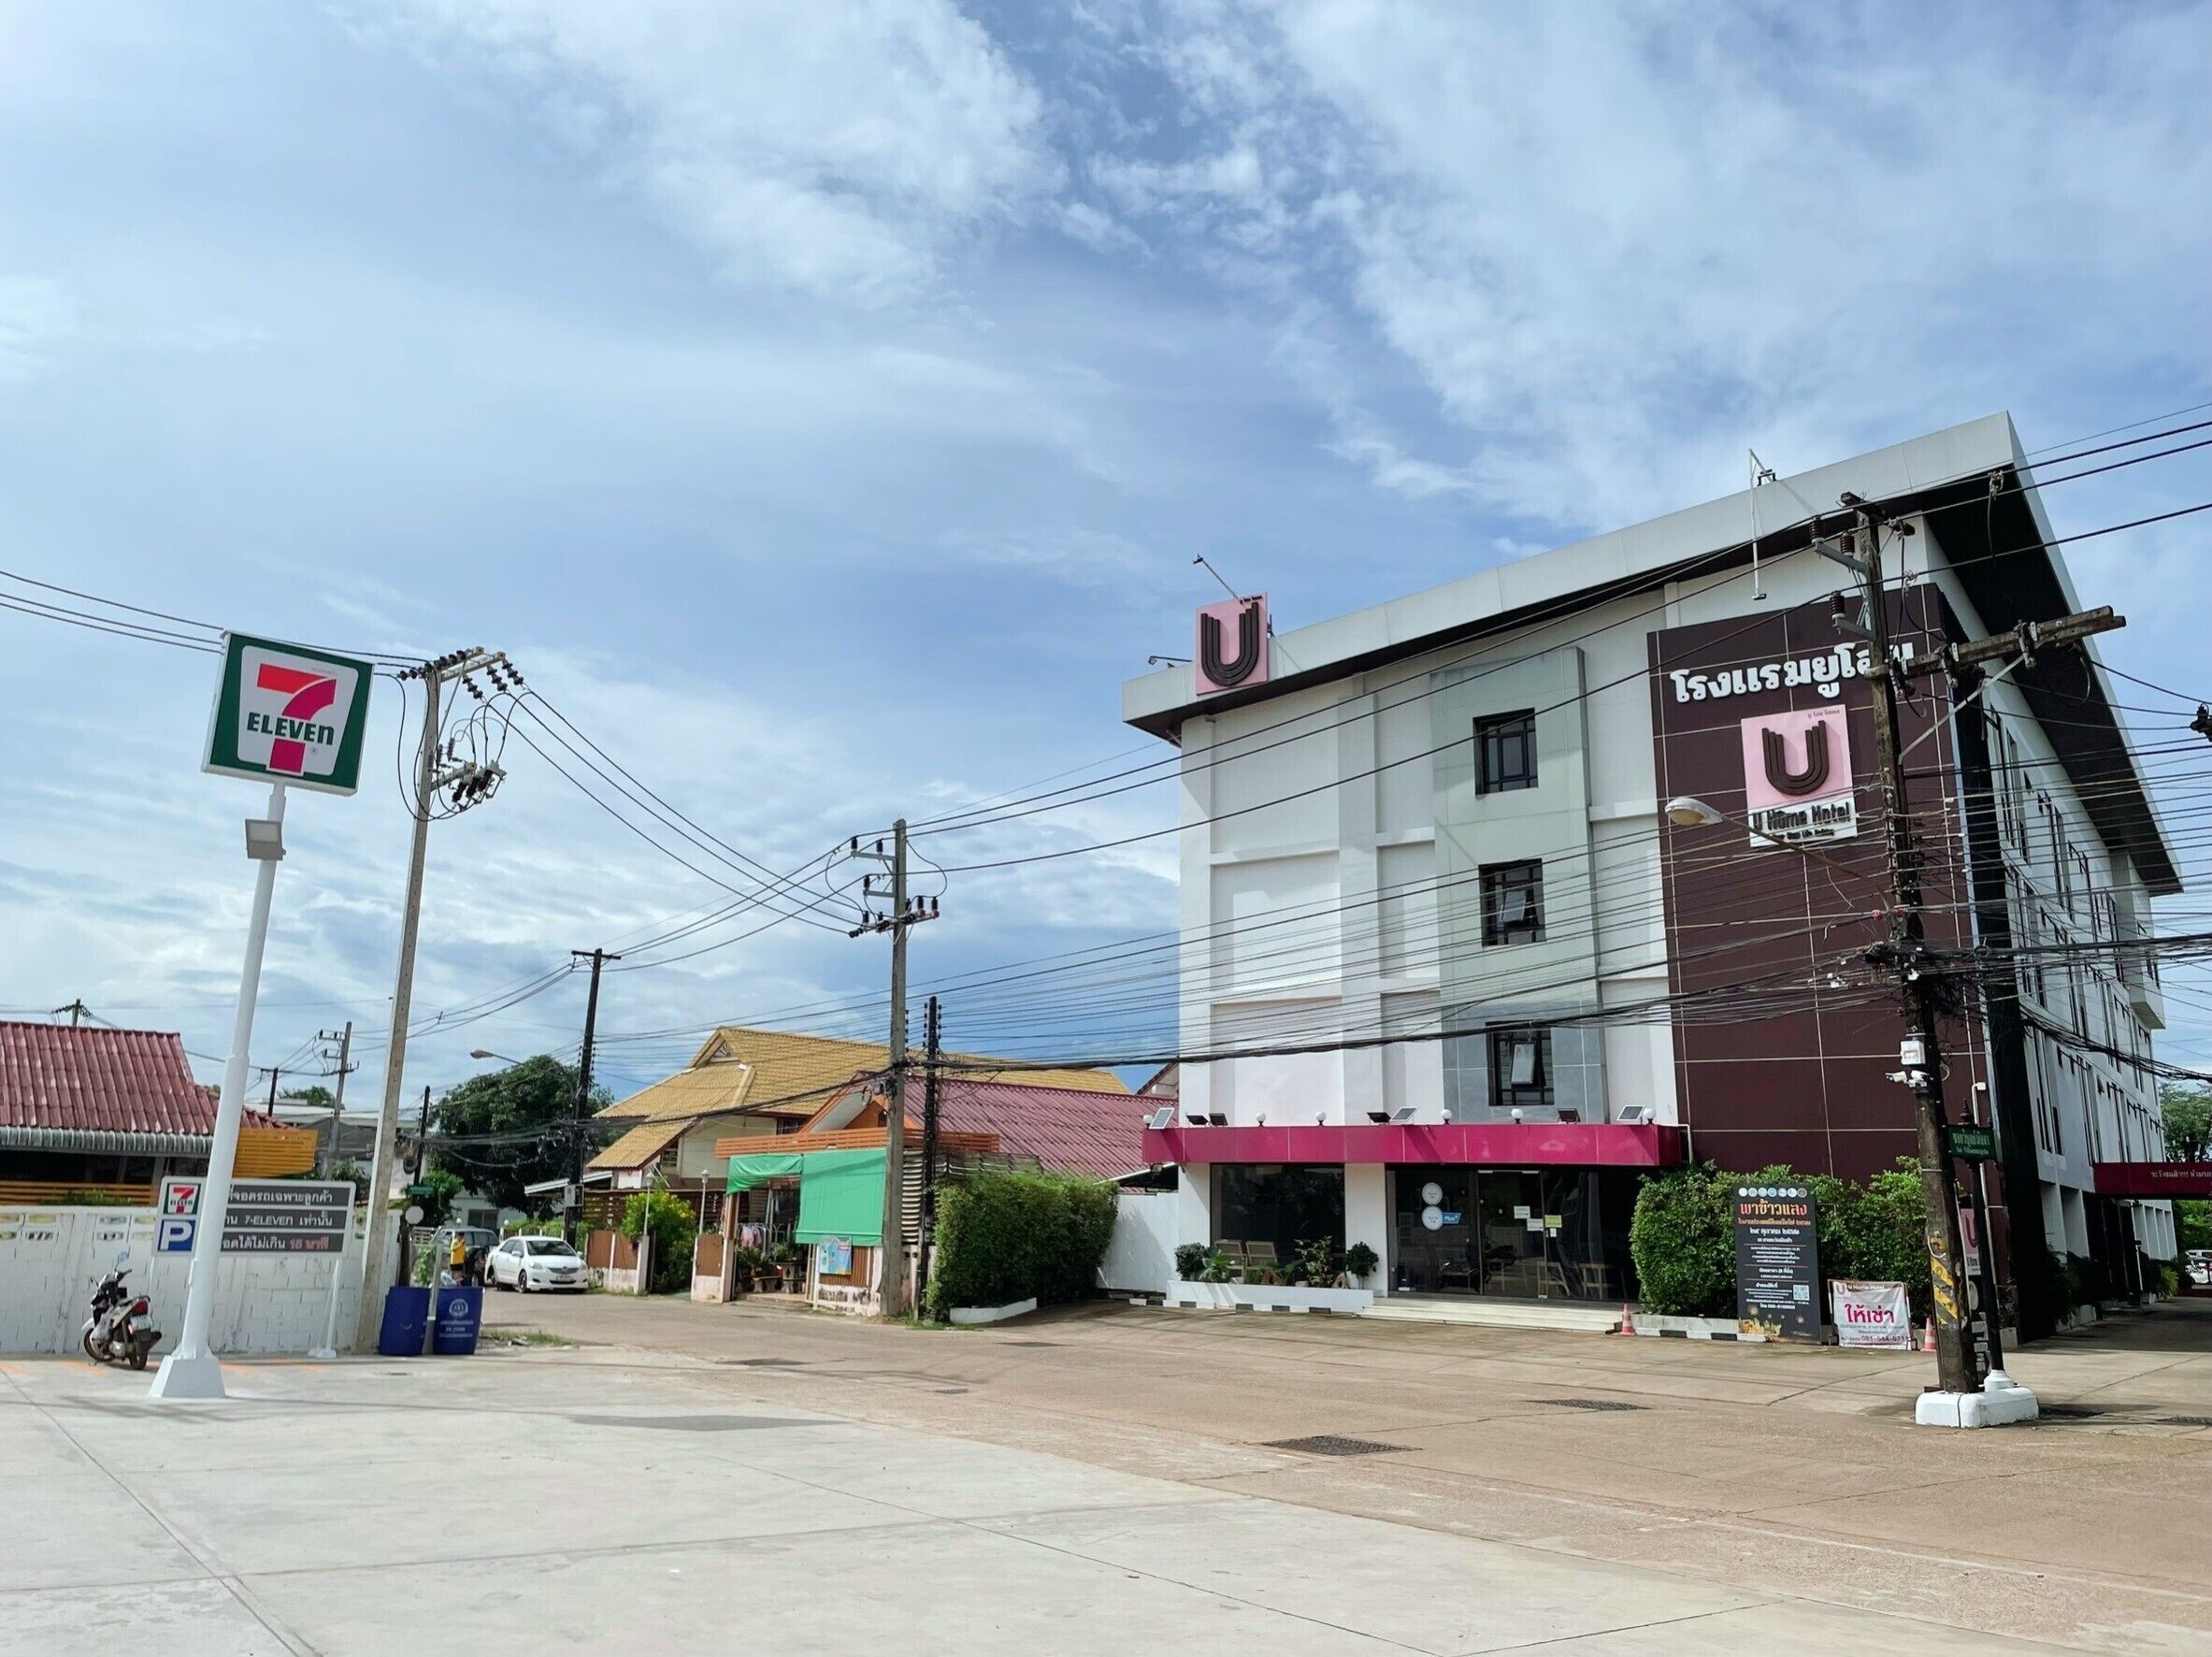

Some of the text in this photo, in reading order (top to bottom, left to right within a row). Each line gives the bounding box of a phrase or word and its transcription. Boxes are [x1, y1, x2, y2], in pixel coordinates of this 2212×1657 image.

[1200, 601, 1259, 686] U
[257, 663, 337, 773] 7
[1761, 720, 1830, 796] U
[1753, 801, 1851, 831] U Home Hotel
[173, 1187, 194, 1214] 7
[1740, 1198, 1808, 1216] พาข้าวแลง
[160, 1220, 193, 1251] P
[223, 1234, 286, 1249] อดได้ไม่เกิน
[1845, 1304, 1895, 1323] ให้เช่า
